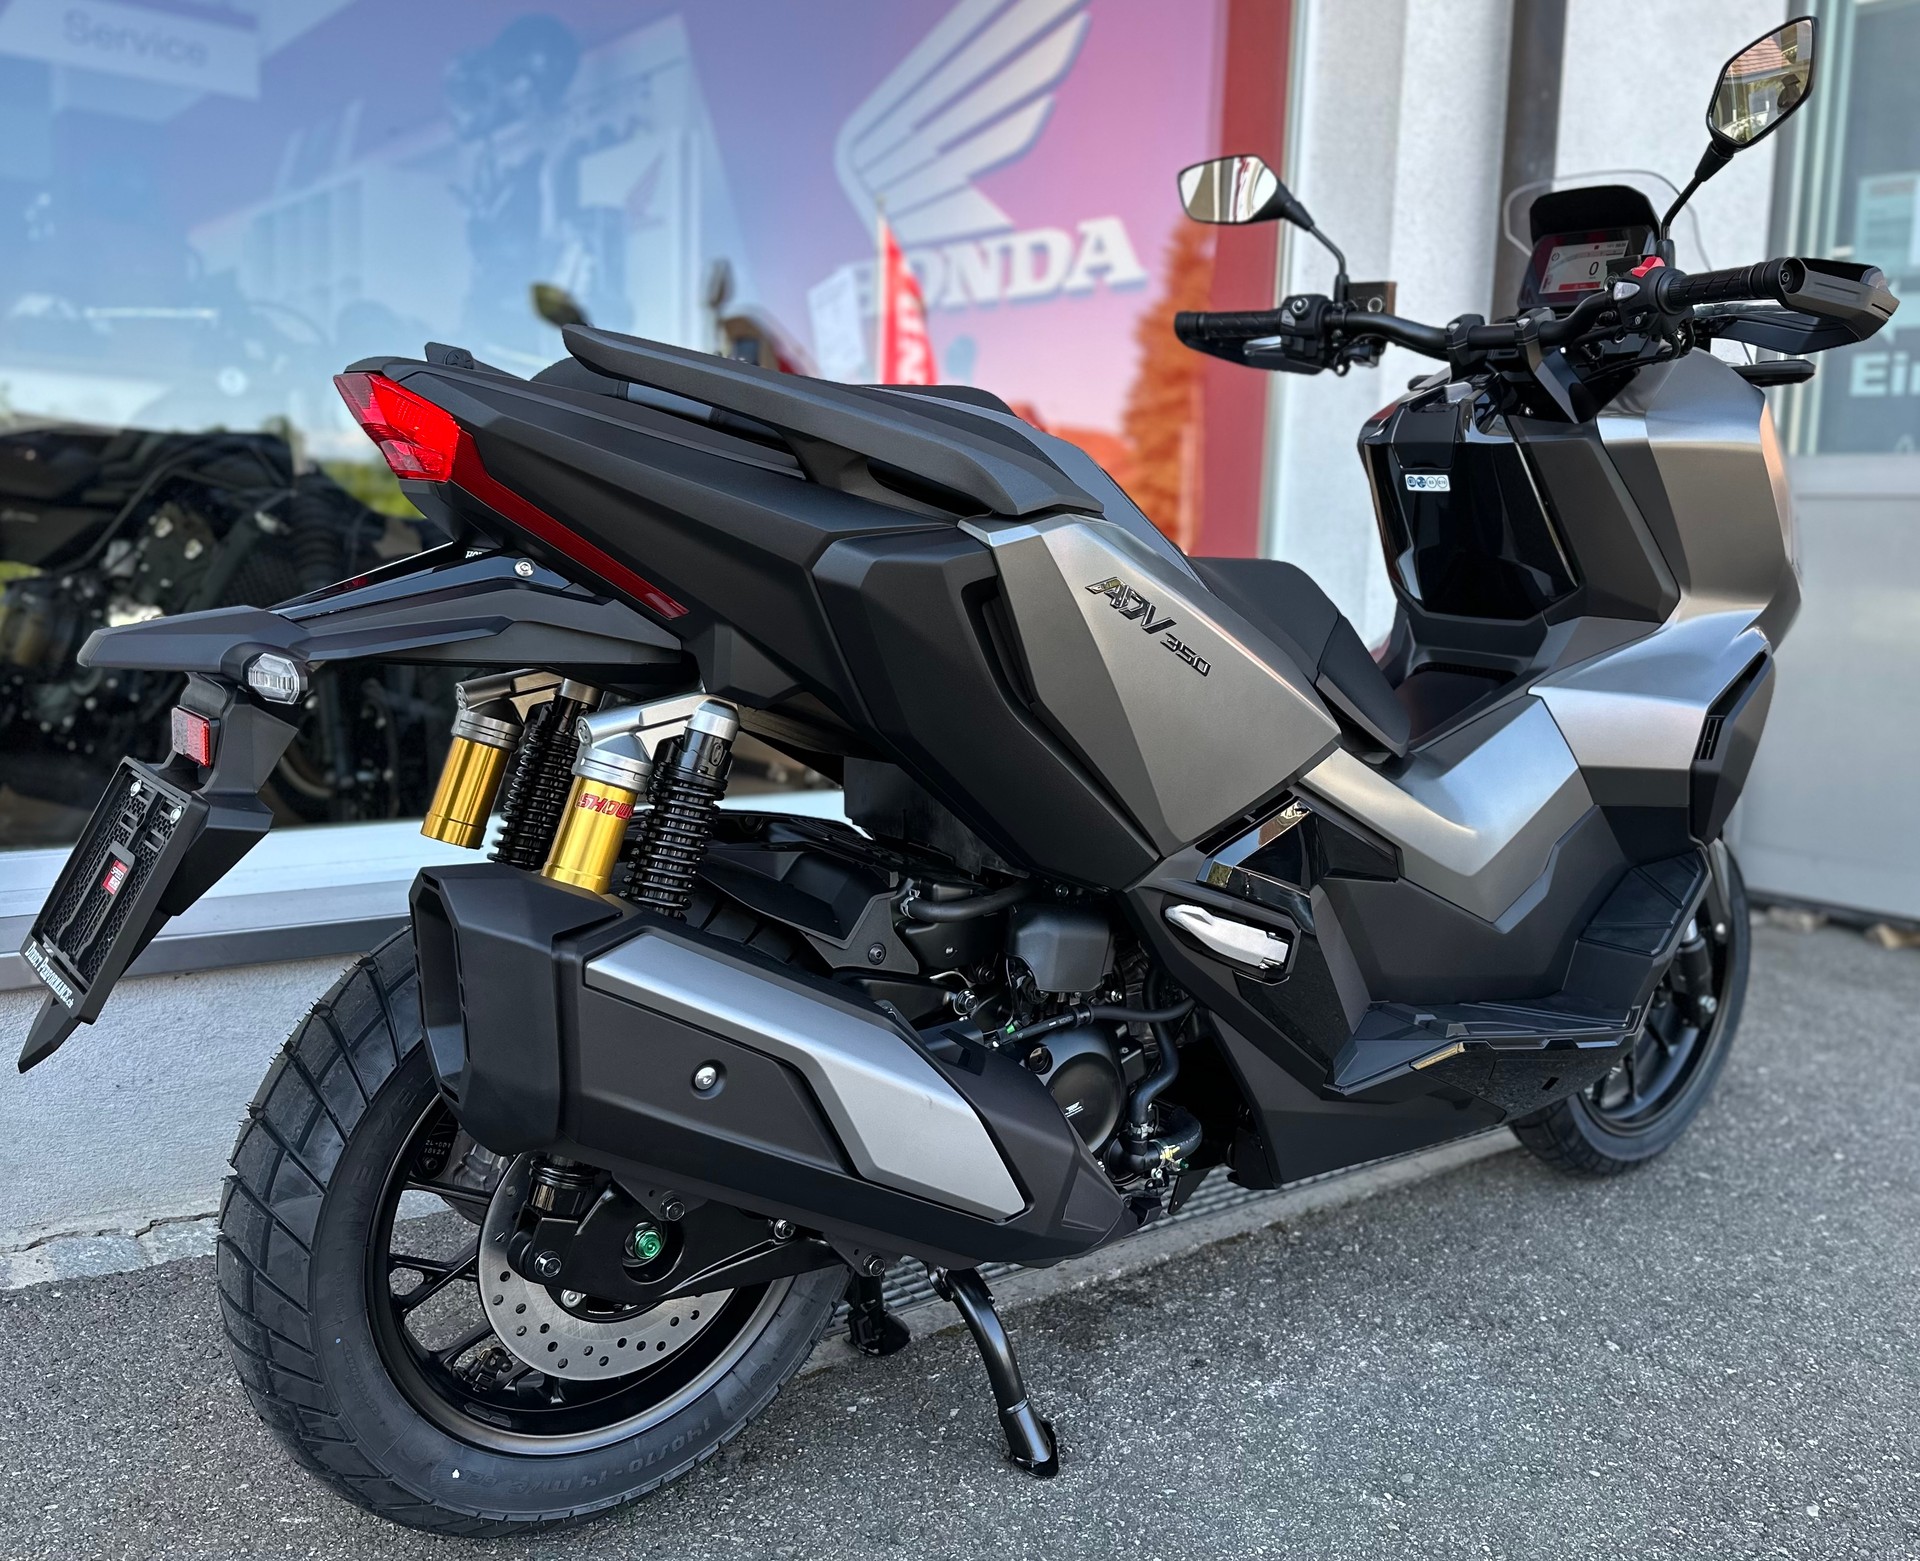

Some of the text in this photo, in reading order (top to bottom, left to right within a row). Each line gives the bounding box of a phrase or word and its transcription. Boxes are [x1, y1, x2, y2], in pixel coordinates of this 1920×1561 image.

[61, 8, 209, 68] Service
[1588, 261, 1600, 276] 0
[1084, 576, 1212, 677] ADV 350
[576, 792, 634, 820] SHOW
